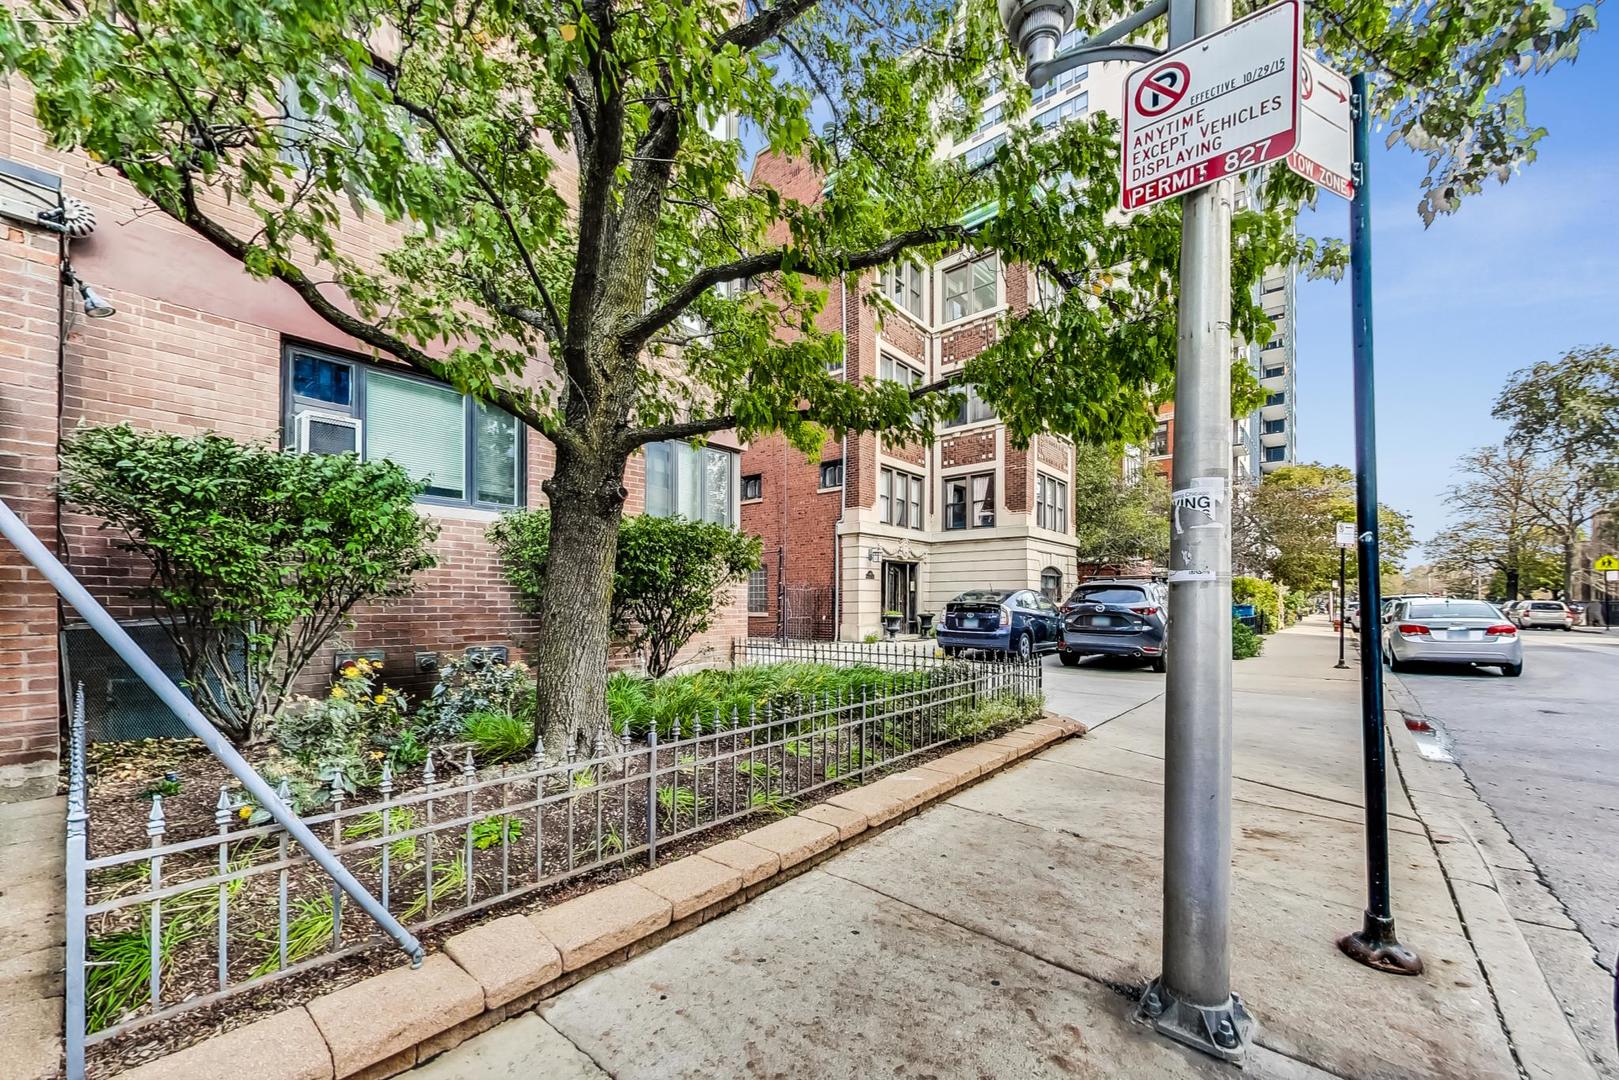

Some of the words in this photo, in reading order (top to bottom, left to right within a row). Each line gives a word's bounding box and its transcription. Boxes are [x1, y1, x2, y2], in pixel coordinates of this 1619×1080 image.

[1190, 78, 1236, 106] EFFECTIVE
[1243, 58, 1286, 84] 10/29/15
[1132, 131, 1189, 167] EXCEPT
[1200, 95, 1282, 139] VEHICLES
[1133, 108, 1206, 151] ANYTIME
[1131, 161, 1210, 207] PERMIT
[1223, 138, 1273, 173] 827
[1132, 136, 1222, 182] DISPLAYING
[1293, 151, 1314, 178] TOW
[1319, 167, 1349, 197] ZONE
